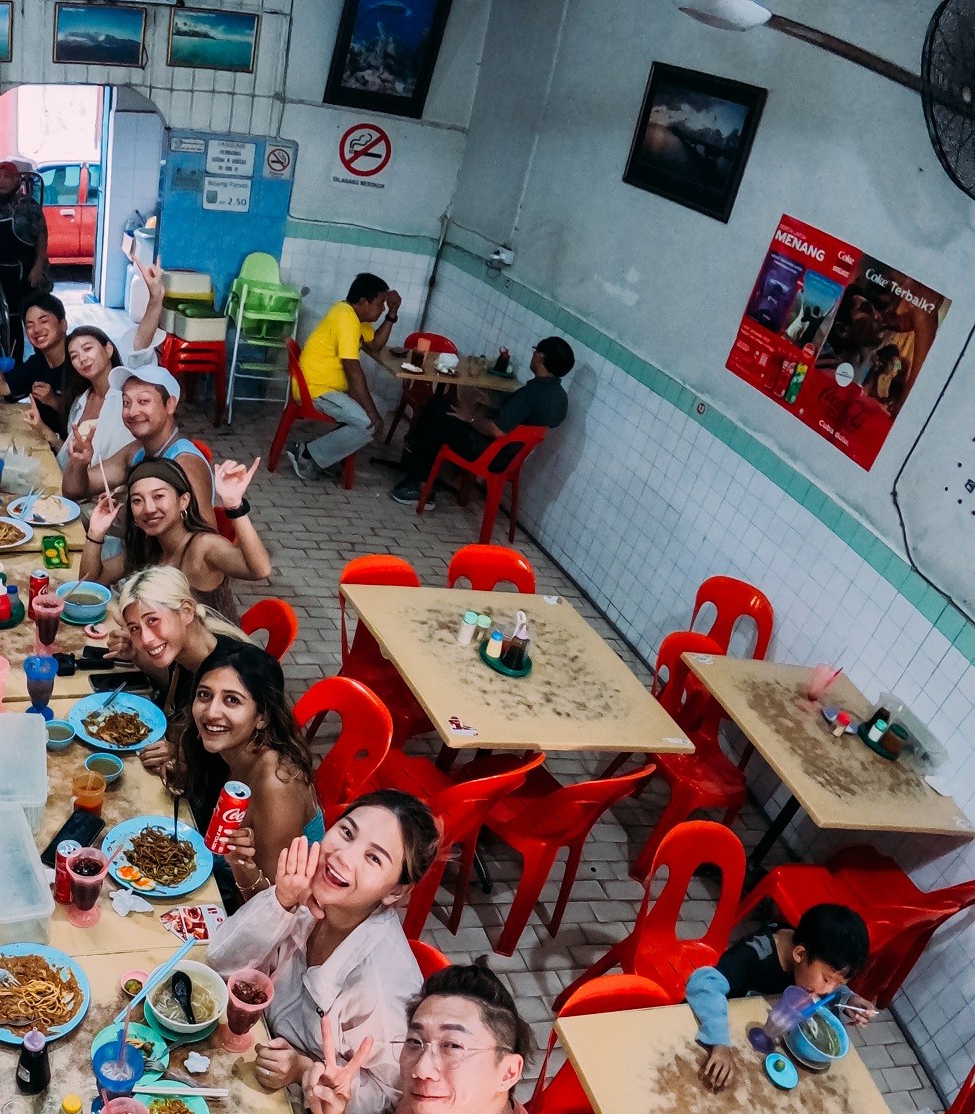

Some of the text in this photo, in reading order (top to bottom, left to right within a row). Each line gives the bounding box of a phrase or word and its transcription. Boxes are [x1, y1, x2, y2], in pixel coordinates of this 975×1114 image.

[227, 197, 247, 207] 2.50
[774, 229, 826, 262] MENANG
[837, 250, 855, 266] Coke
[864, 267, 889, 289] Coke
[889, 280, 936, 314] Terbaik?
[818, 419, 835, 435] Cuba
